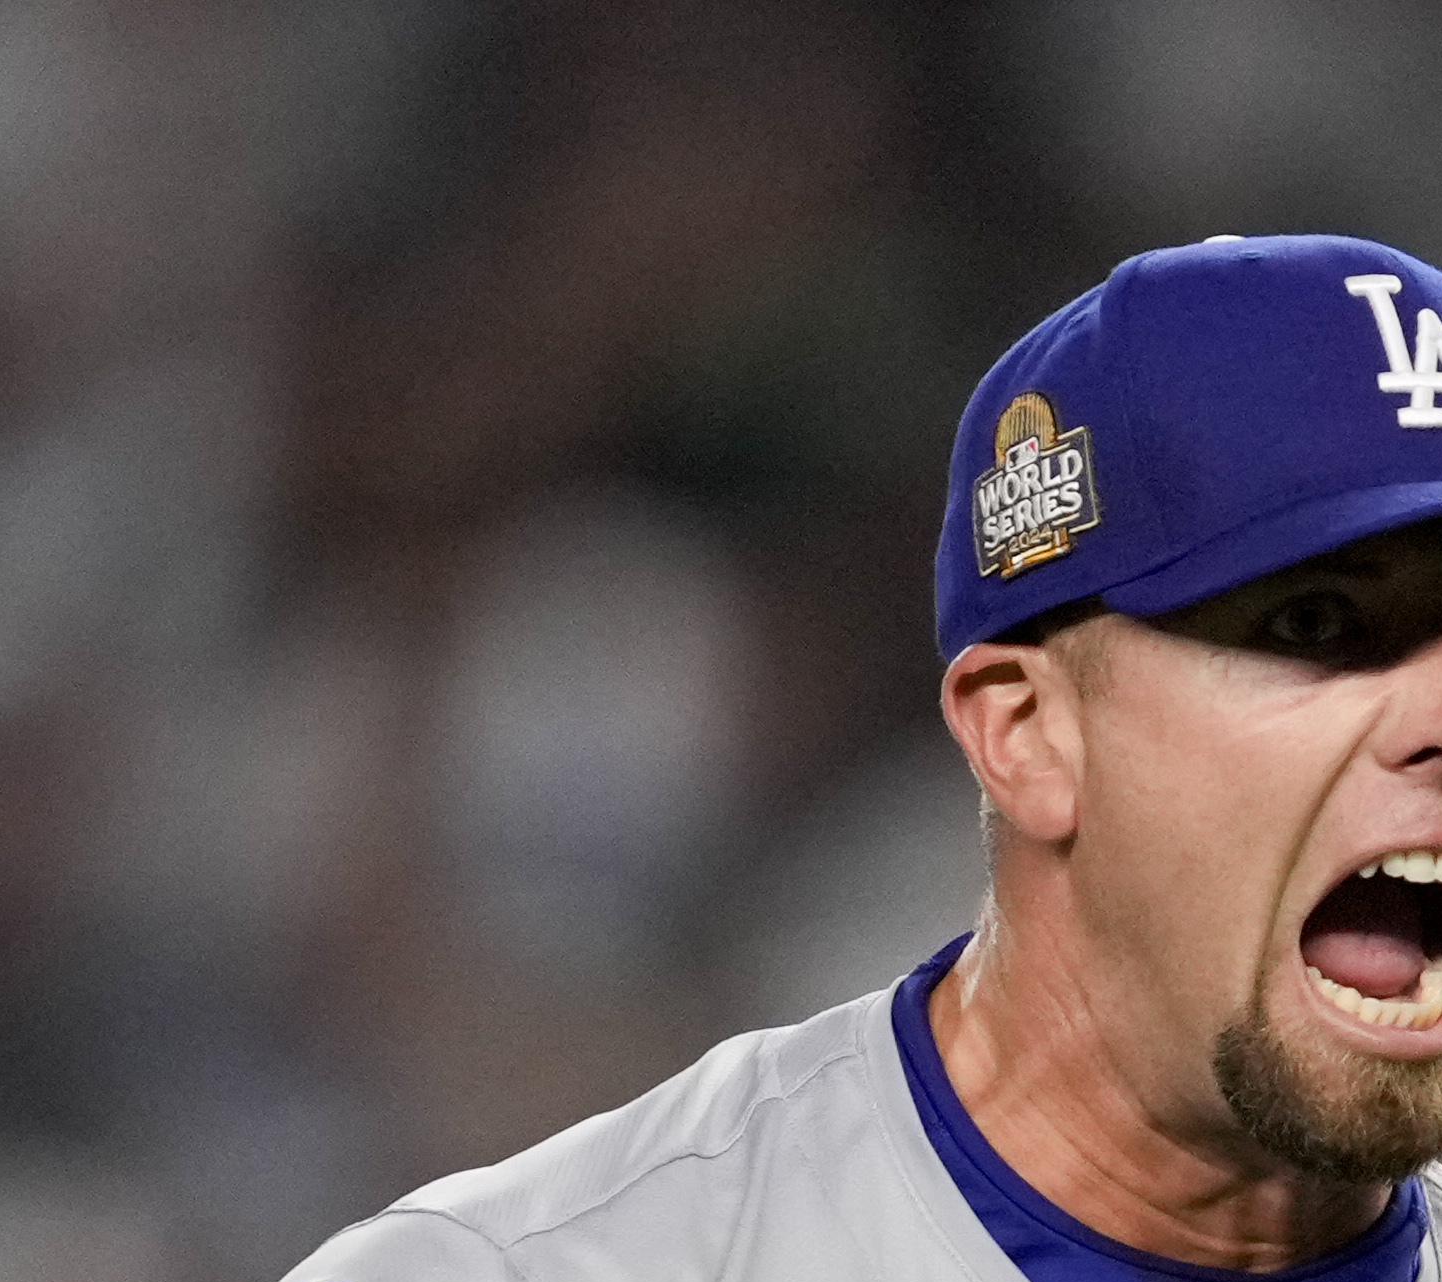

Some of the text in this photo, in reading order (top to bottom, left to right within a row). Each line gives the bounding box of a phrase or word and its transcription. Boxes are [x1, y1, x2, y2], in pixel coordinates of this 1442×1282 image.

[978, 449, 1083, 518] WORLD
[983, 482, 1083, 549] SERIES
[1009, 523, 1053, 553] 2024
